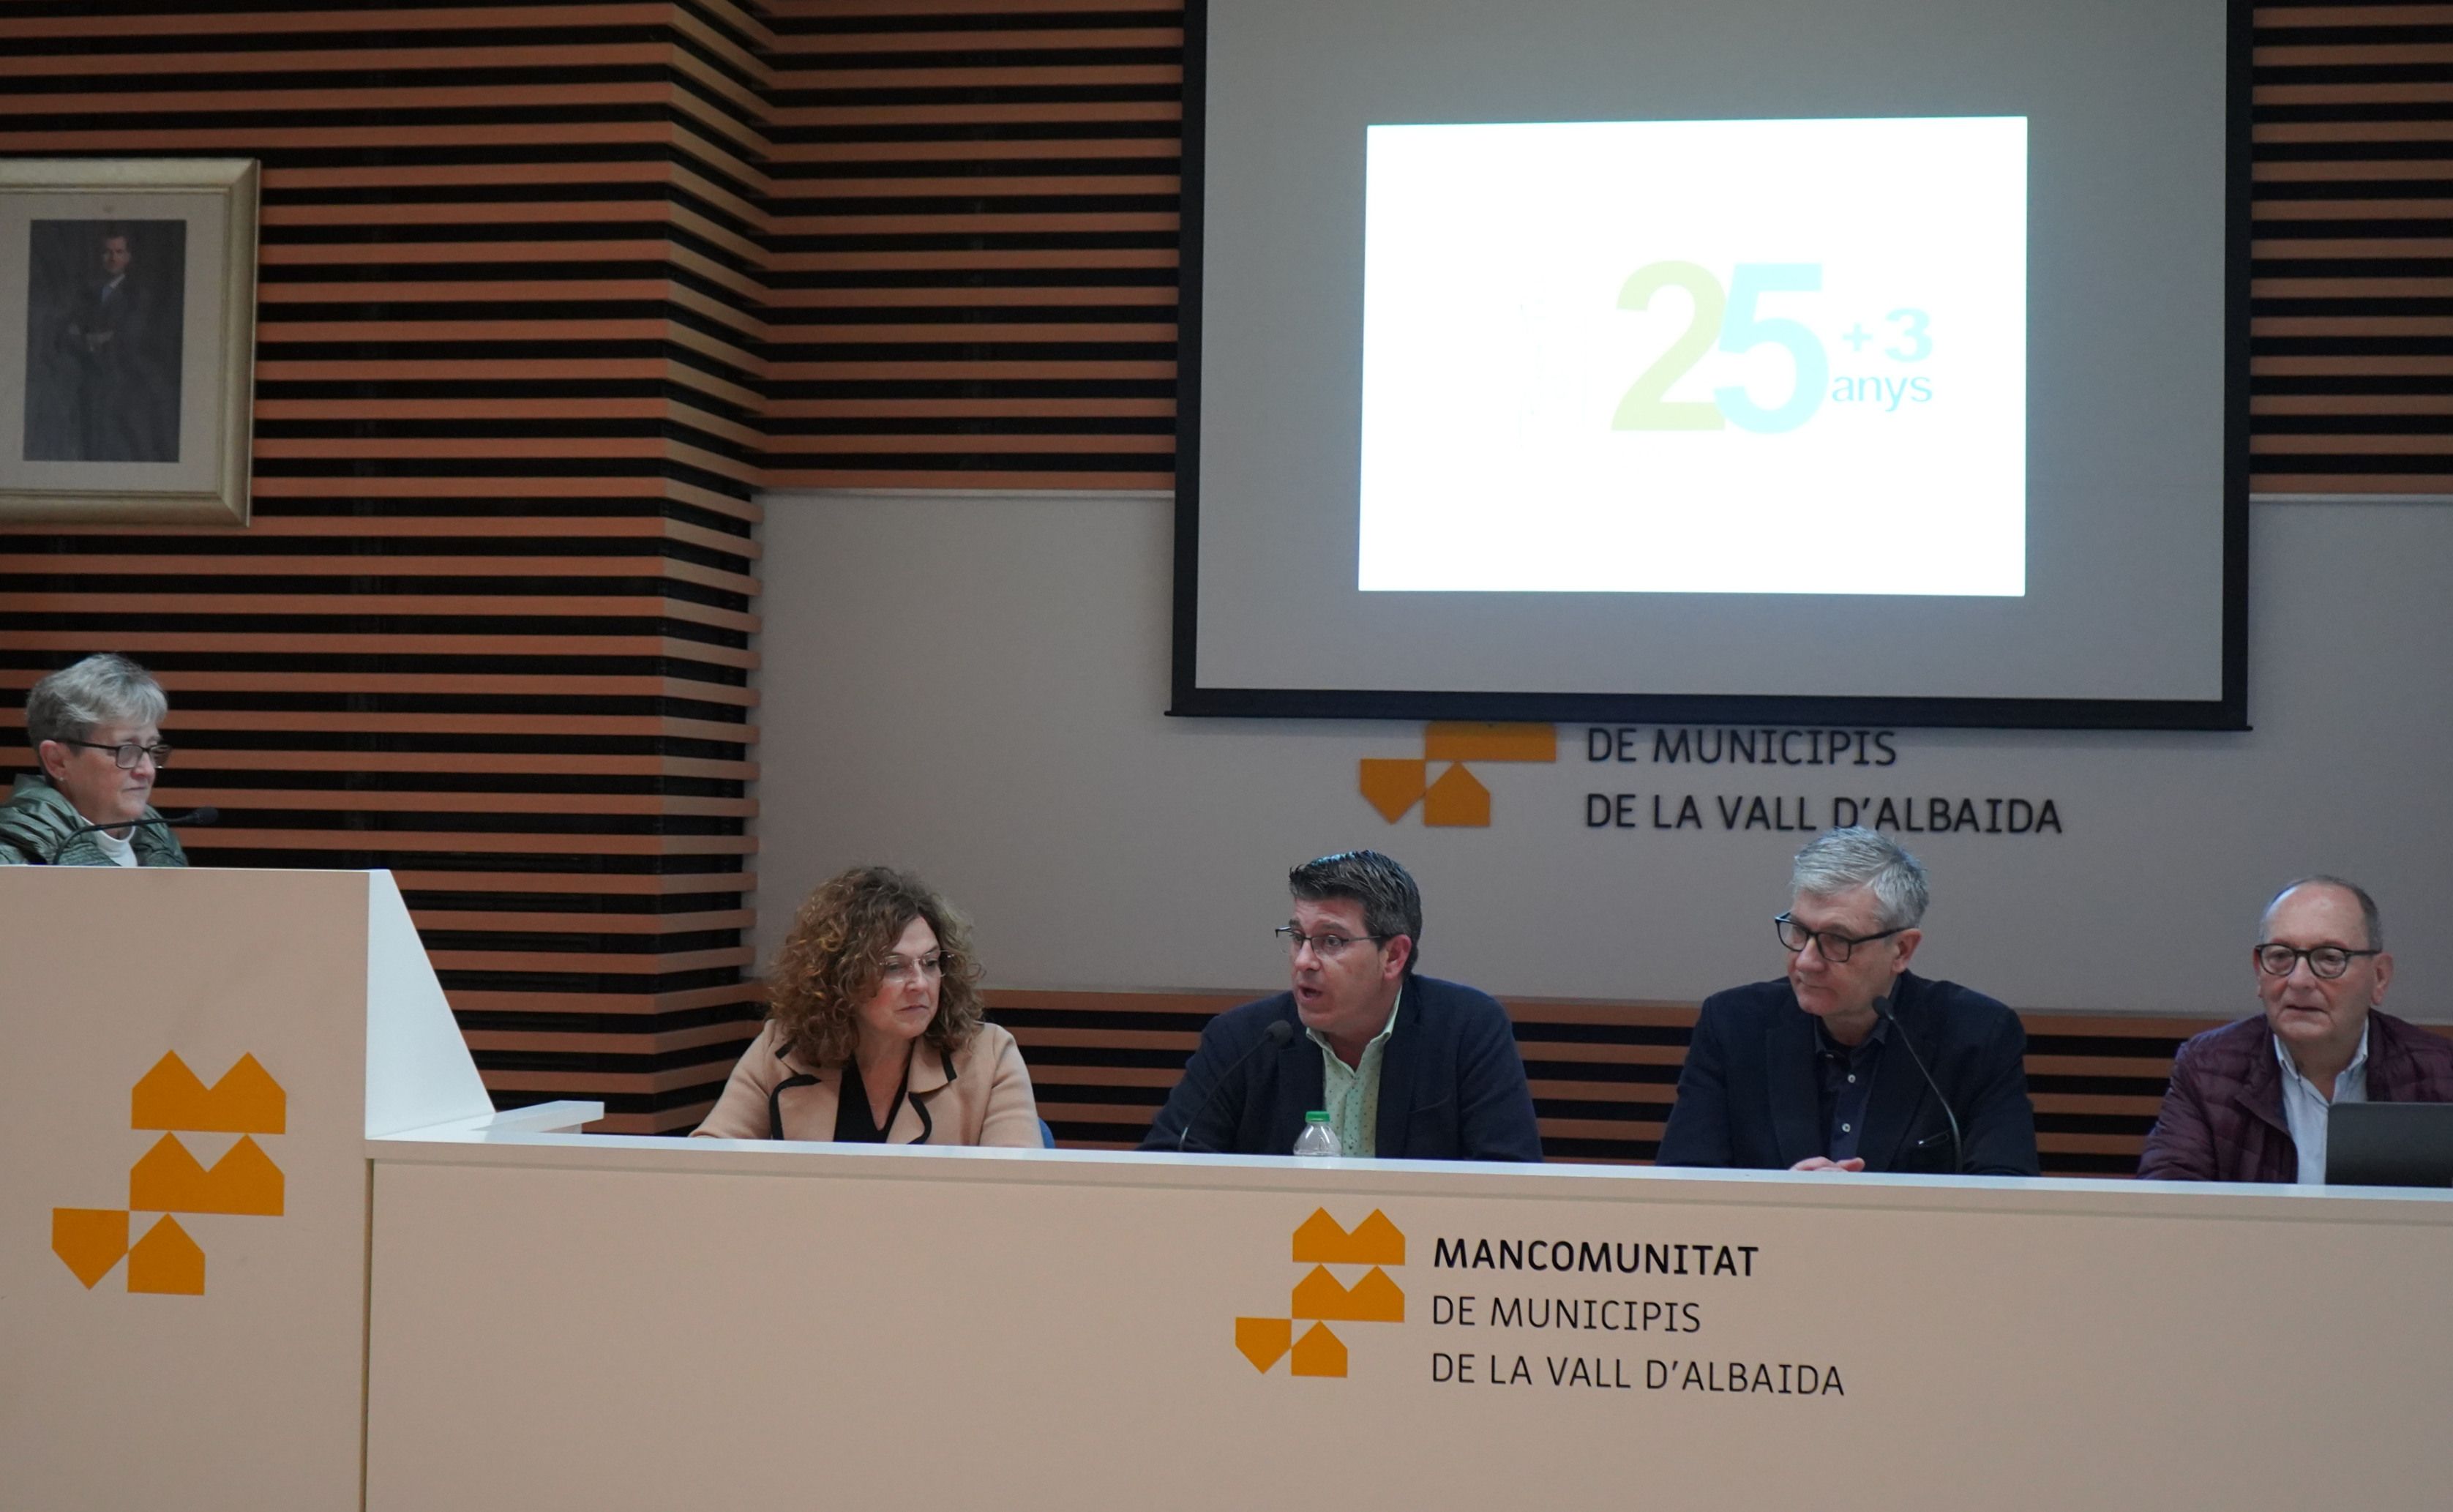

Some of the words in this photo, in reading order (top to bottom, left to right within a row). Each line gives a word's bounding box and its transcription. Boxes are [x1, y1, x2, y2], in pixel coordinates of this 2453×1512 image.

[1611, 260, 1830, 435] 25
[1831, 374, 1934, 414] anys
[1587, 727, 1637, 762] DE
[1654, 729, 1896, 766] MUNICIPIS
[1587, 793, 1636, 828] DE
[1653, 794, 1703, 830] LA
[1717, 795, 1817, 831] VALL
[1833, 796, 2063, 834] D'ALBAIDA
[1434, 1237, 1759, 1277] MANCOMUNITAT
[1433, 1295, 1476, 1326] DE
[1490, 1297, 1701, 1333] MUNICIPIS
[1432, 1352, 1475, 1384] DE
[1491, 1354, 1532, 1385] LA
[1546, 1356, 1631, 1389] VALL
[1647, 1359, 1845, 1396] D'ALBAIDA
